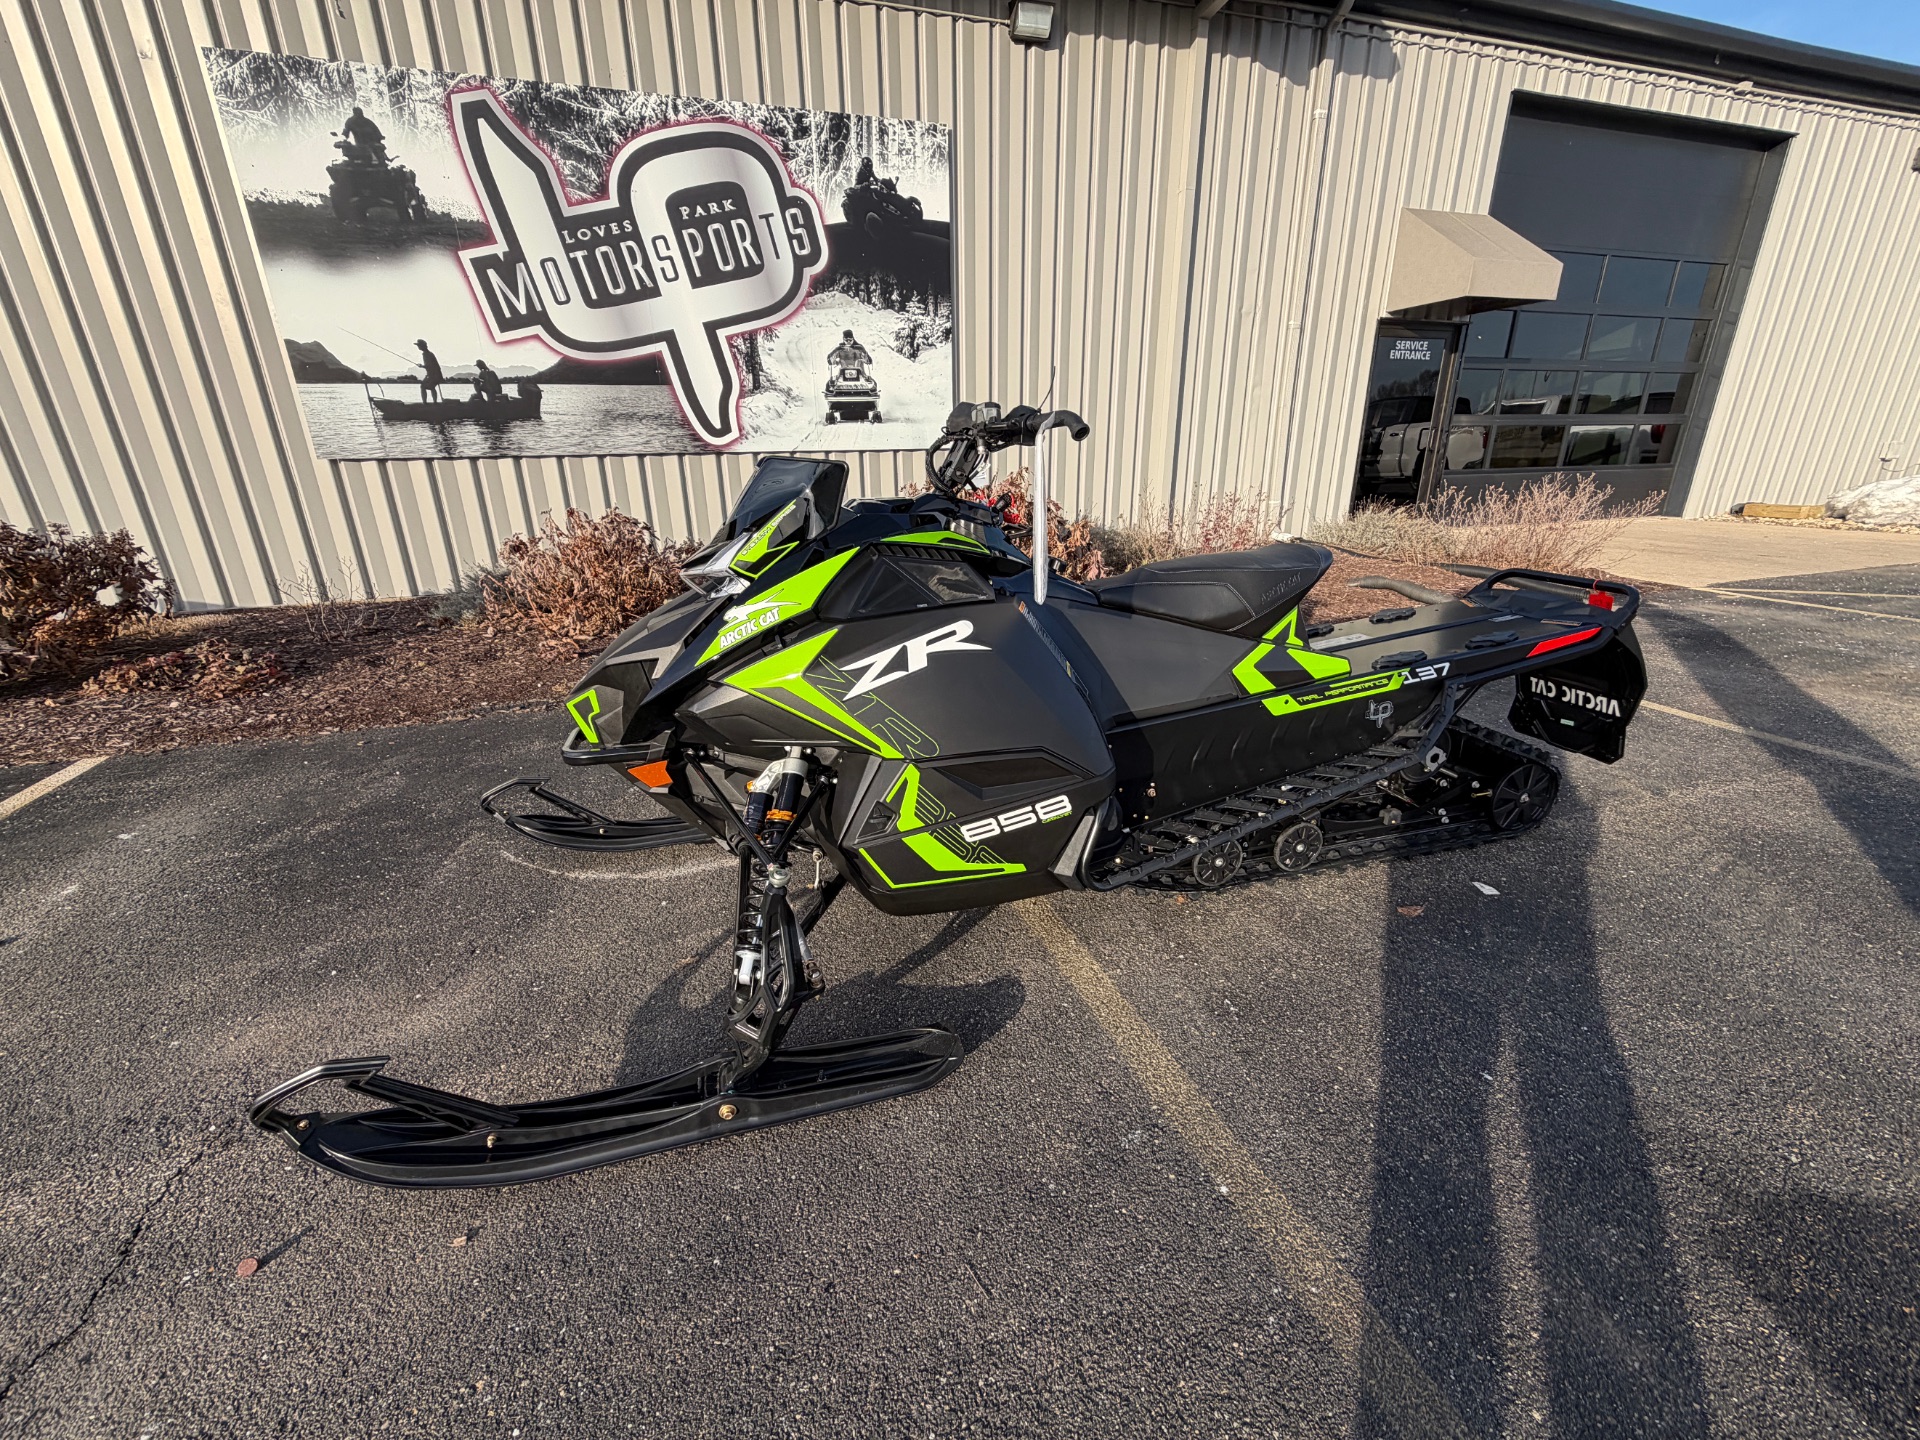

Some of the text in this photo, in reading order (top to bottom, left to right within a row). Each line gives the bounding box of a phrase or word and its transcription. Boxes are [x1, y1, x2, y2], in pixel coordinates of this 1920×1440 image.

[561, 198, 737, 244] LOVES PARK
[486, 207, 813, 319] MOTORSPORTS
[1389, 350, 1431, 360] ENTRANCE
[1395, 340, 1429, 350] SERVICE
[720, 607, 781, 650] ARCTIC CAT
[839, 620, 992, 701] ZR
[1401, 662, 1450, 685] 137
[960, 795, 1072, 842] 858
